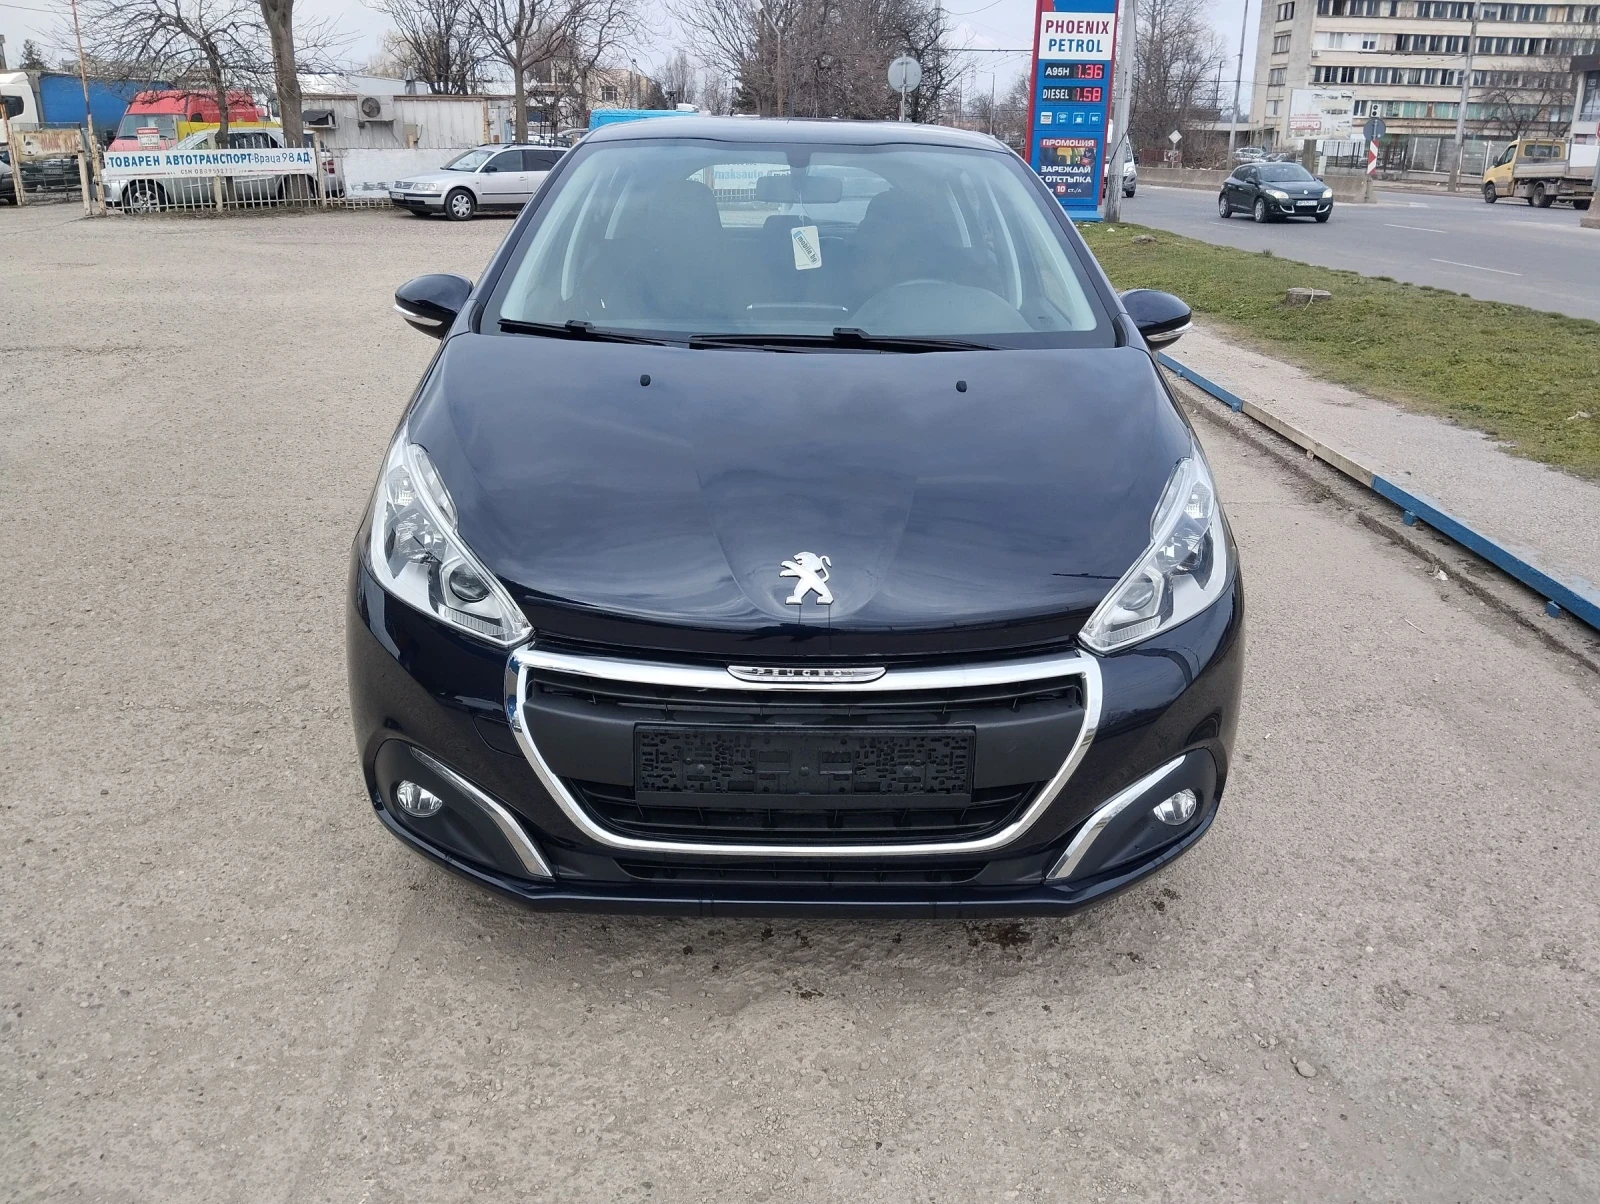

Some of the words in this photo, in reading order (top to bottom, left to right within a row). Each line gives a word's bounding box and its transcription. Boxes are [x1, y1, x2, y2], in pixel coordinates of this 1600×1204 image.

[1045, 20, 1110, 34] PHOENIX
[1048, 39, 1103, 52] PETROL
[1077, 64, 1103, 79] 1.36
[1042, 89, 1069, 99] DIESEL
[1075, 88, 1102, 102] 1.58
[1043, 139, 1095, 147] ПРОМОЦИЯ
[108, 155, 160, 168] ТОВАРЕН
[296, 151, 311, 165] АД
[1041, 165, 1091, 173] ЗАРЕЖДАЙ
[1045, 175, 1092, 183] ОТСТЪПКА
[1056, 185, 1066, 193] 10
